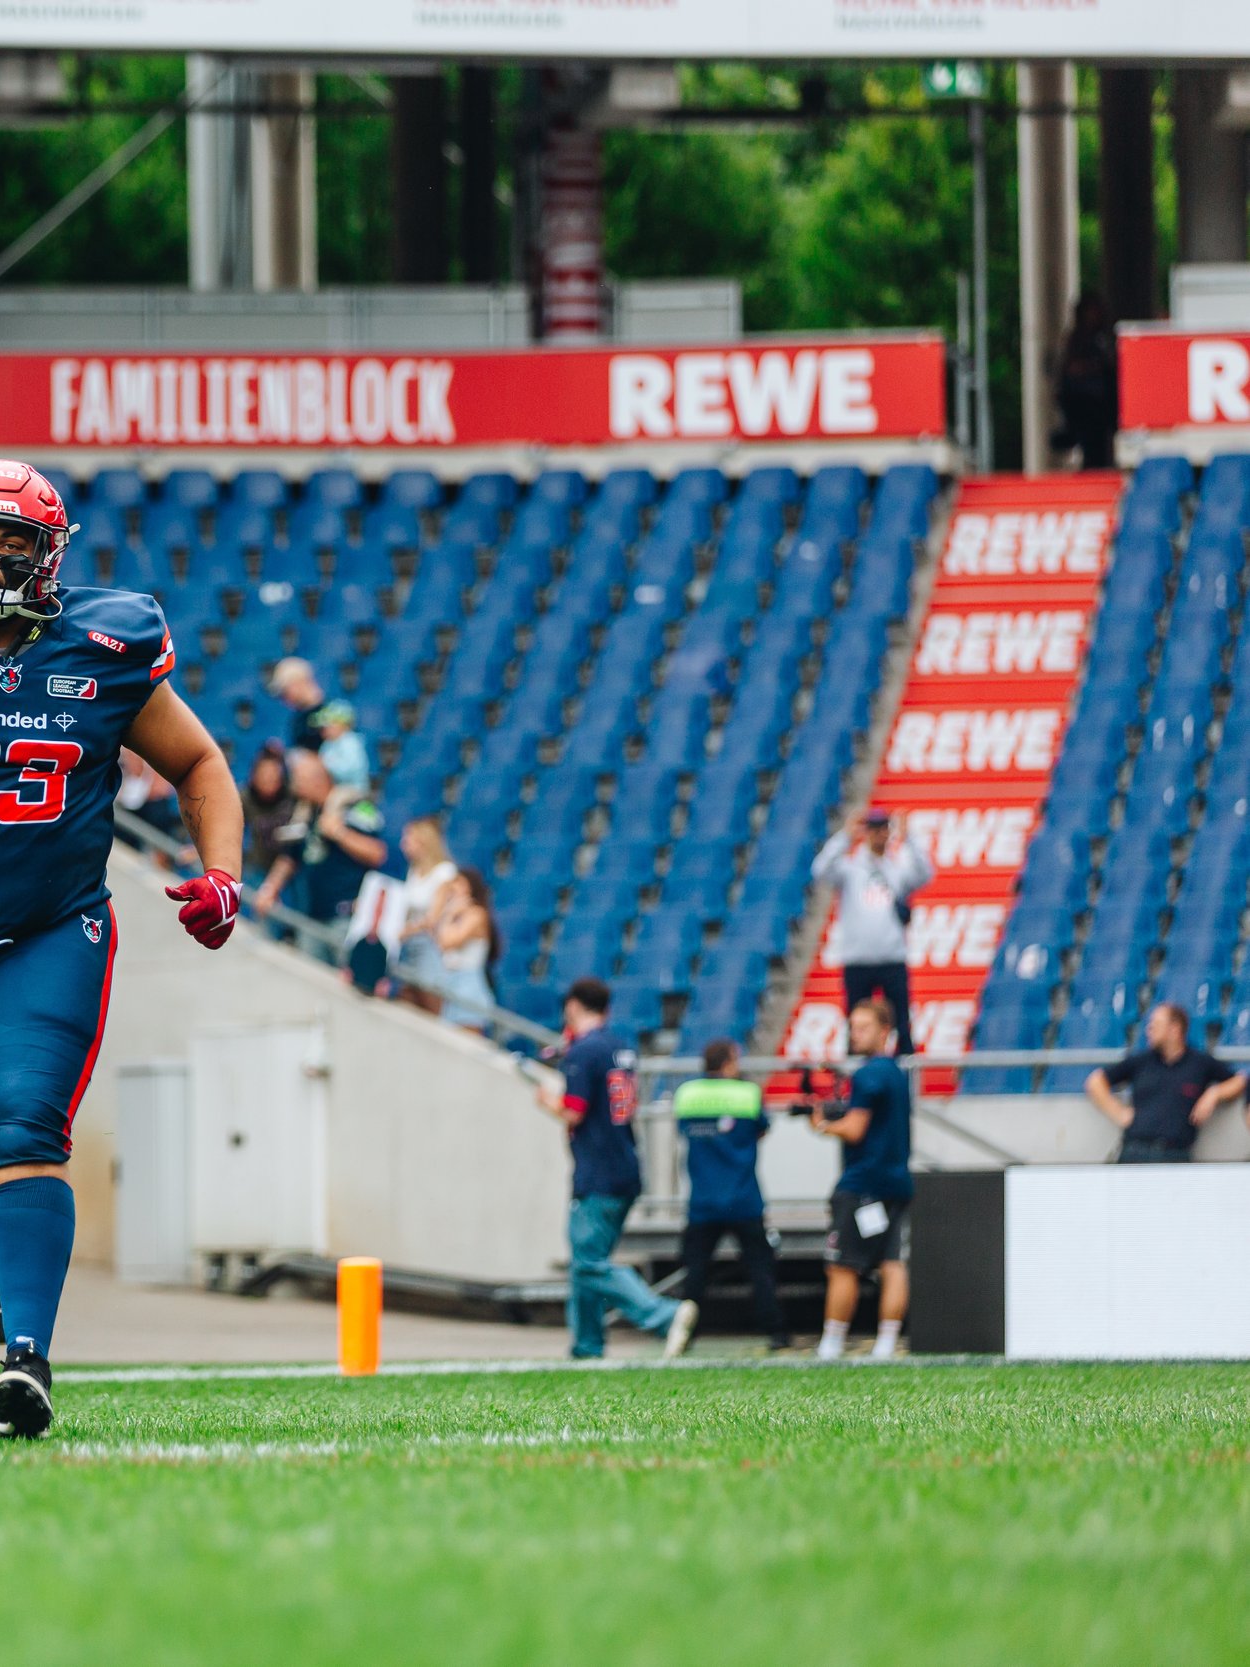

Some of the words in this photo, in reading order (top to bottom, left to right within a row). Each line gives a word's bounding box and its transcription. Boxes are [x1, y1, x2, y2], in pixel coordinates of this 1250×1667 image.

[50, 357, 456, 444] FAMILIENBLOCK
[609, 349, 878, 438] REWE
[943, 510, 1109, 575] REWE
[916, 610, 1085, 675] REWE
[887, 709, 1060, 772] REWE
